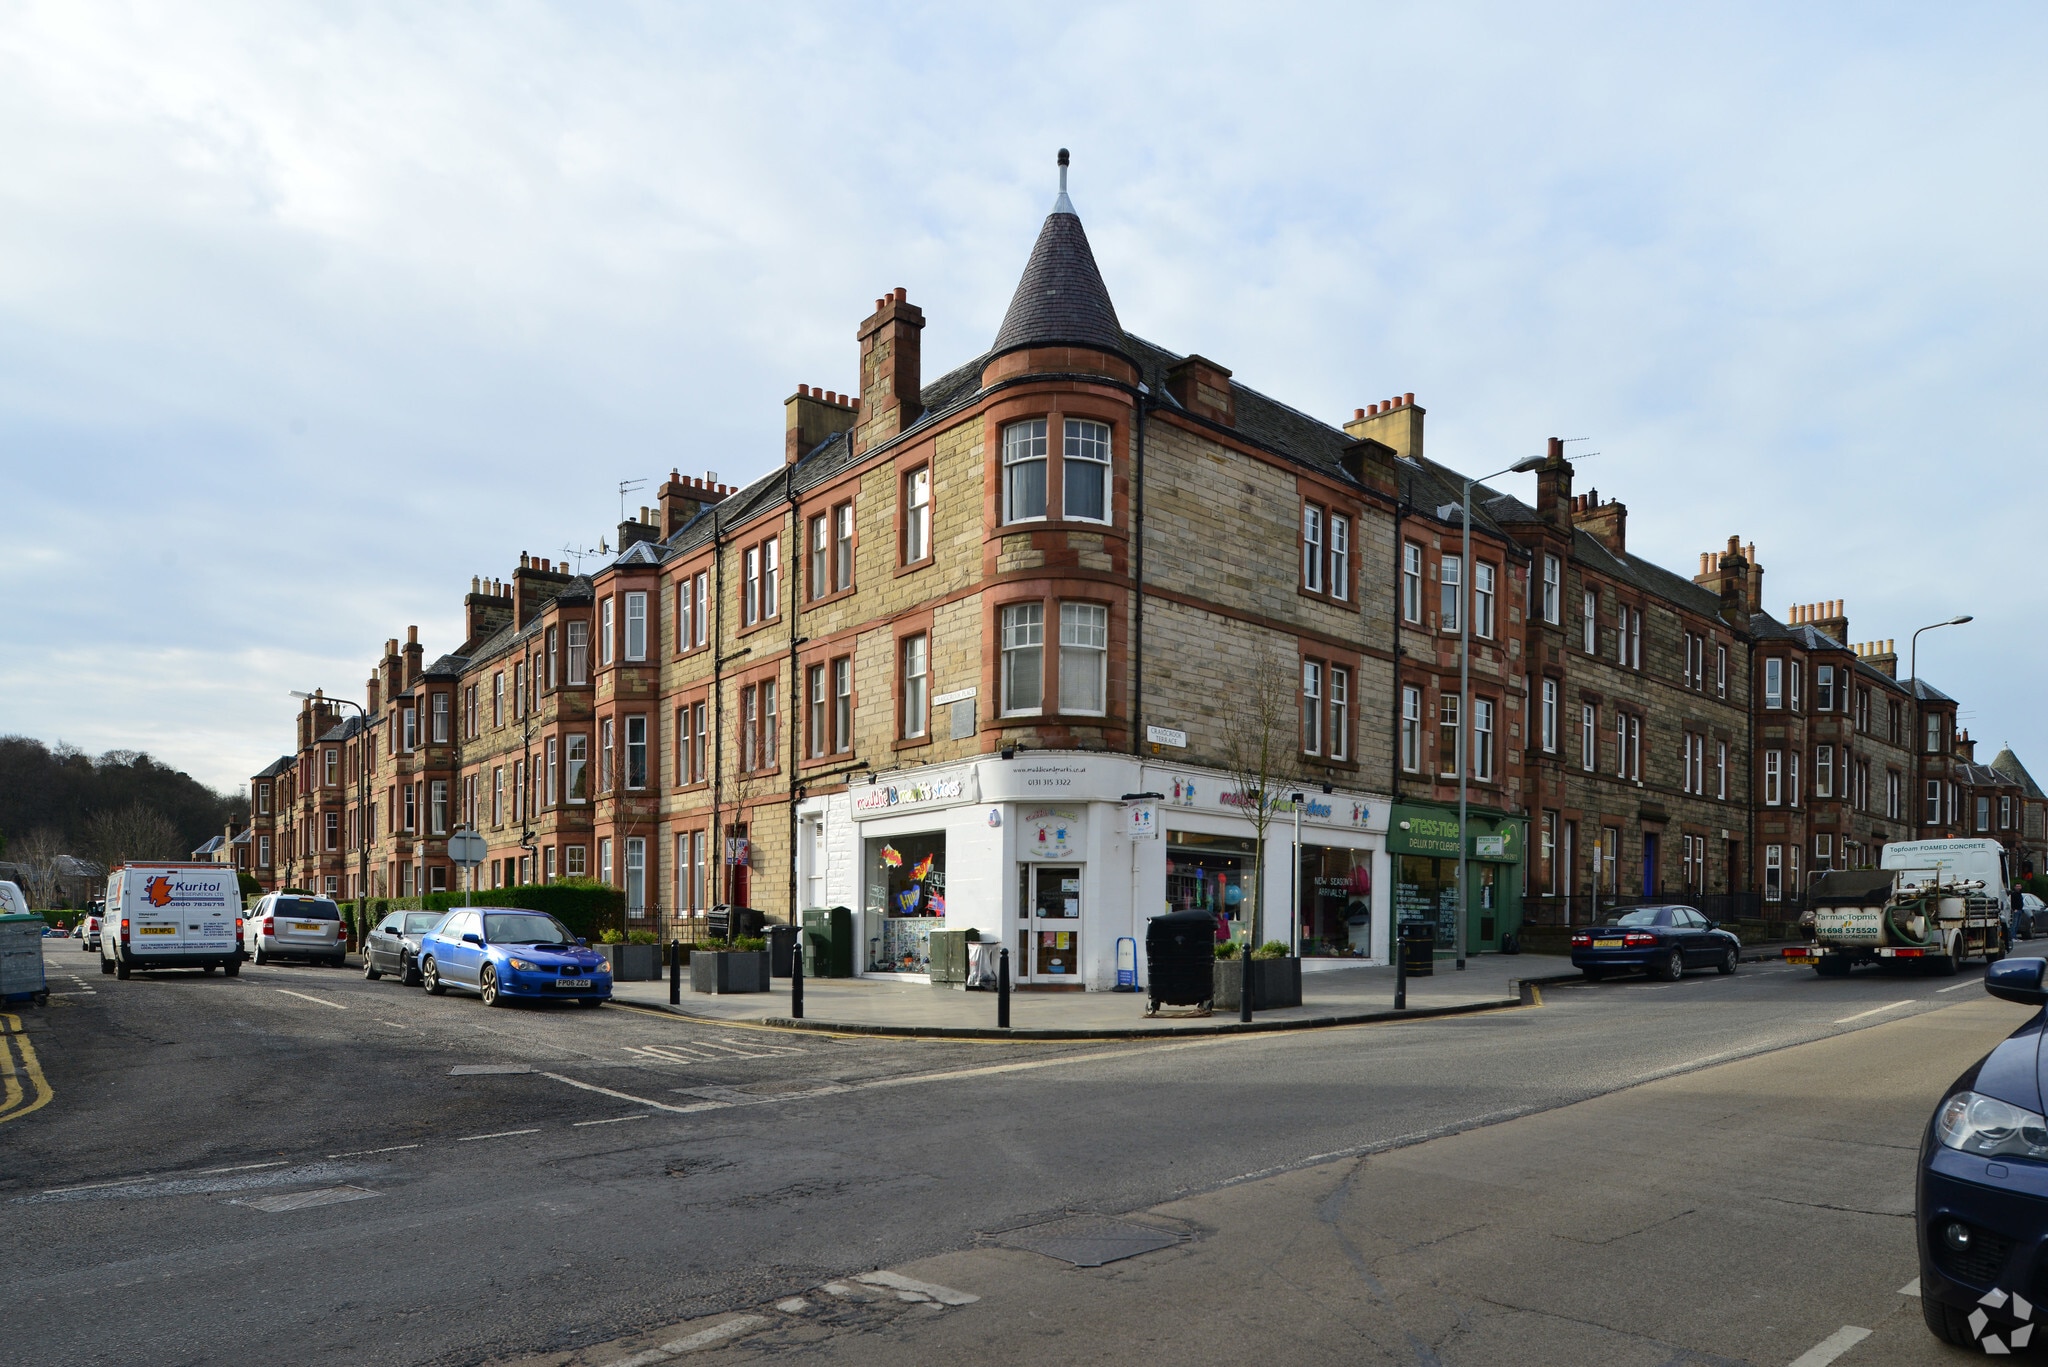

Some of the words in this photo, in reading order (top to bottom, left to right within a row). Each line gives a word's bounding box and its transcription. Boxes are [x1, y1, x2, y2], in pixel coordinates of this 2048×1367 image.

[1156, 735, 1177, 744] TERRACE
[889, 786, 898, 804] &
[1307, 798, 1332, 817] shoes
[1314, 876, 1327, 886] NEW
[175, 882, 220, 891] Kuritol
